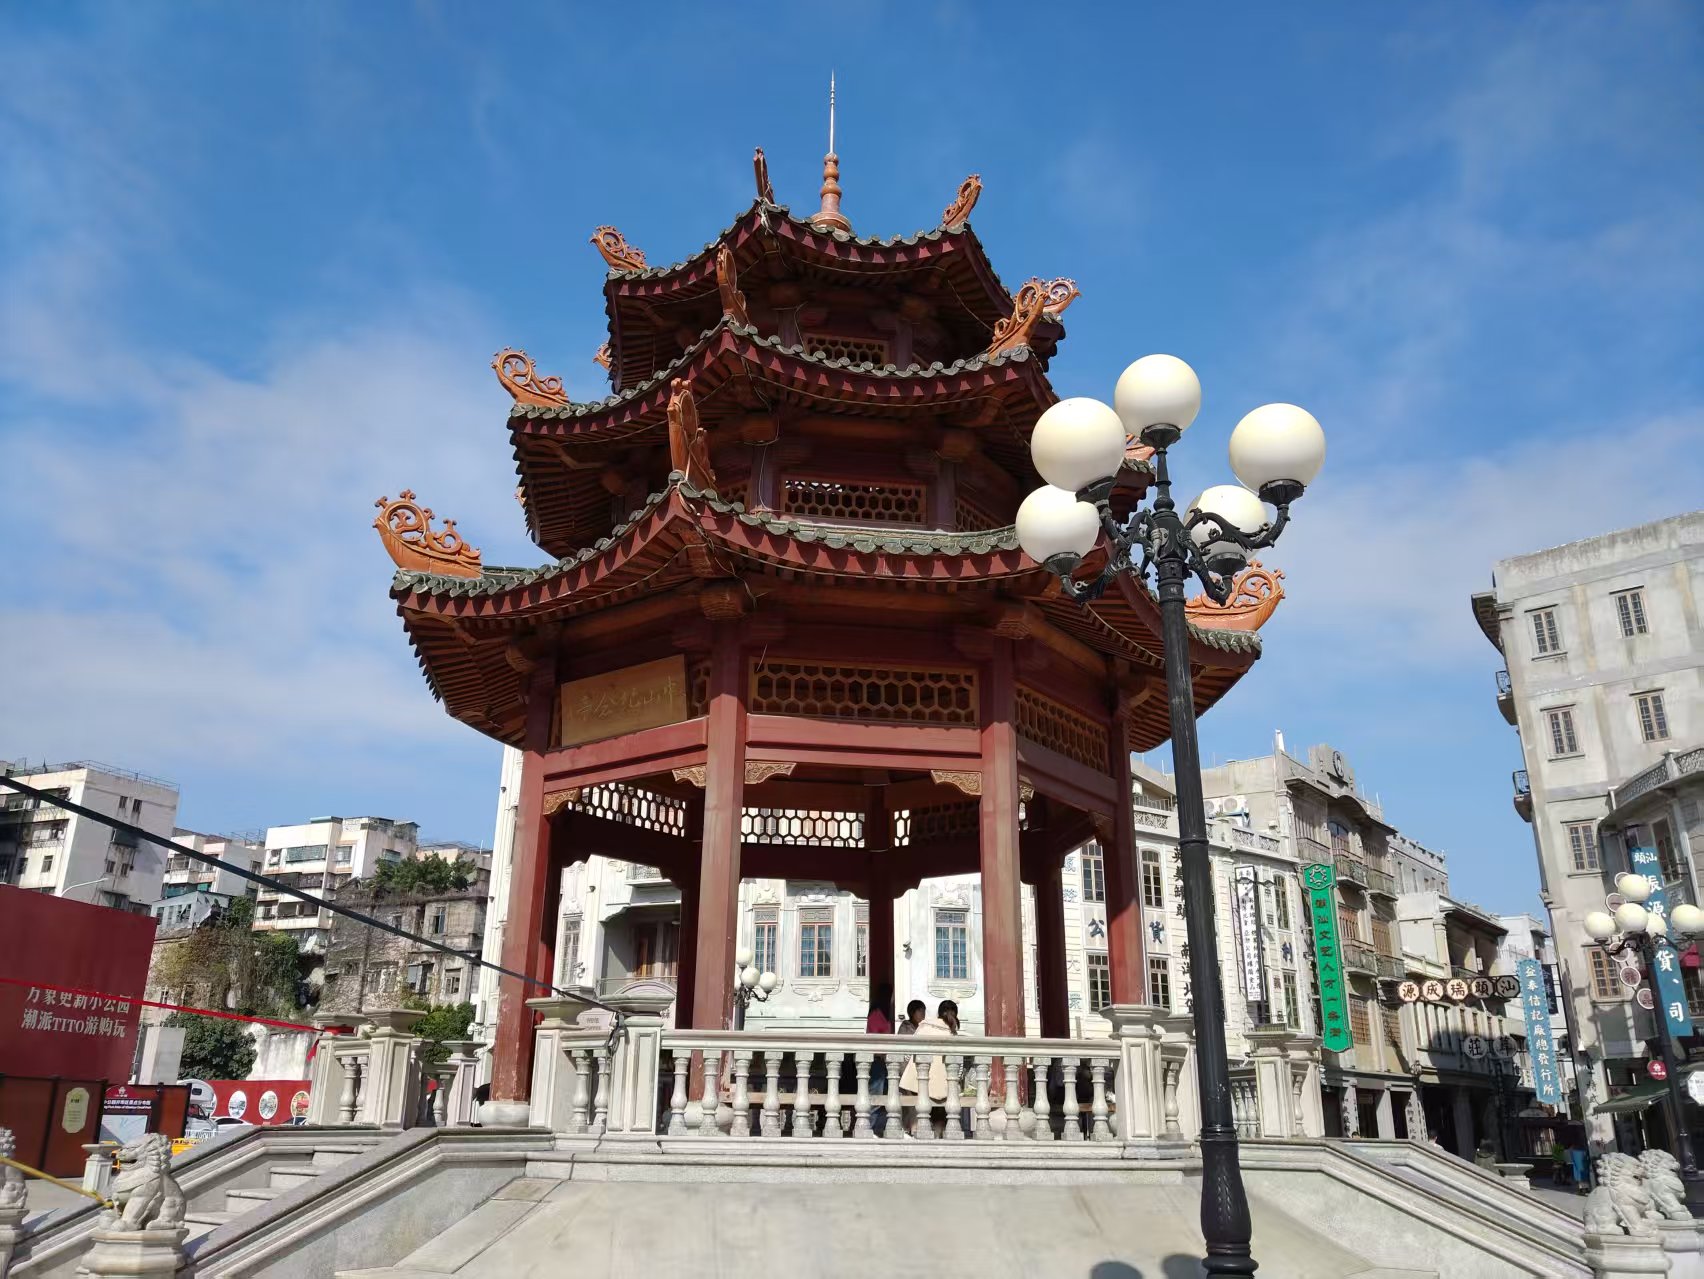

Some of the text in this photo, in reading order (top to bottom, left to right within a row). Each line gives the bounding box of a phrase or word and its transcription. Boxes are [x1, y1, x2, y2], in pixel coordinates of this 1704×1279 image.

[21, 1008, 127, 1038] 潮派TITO游购玩
